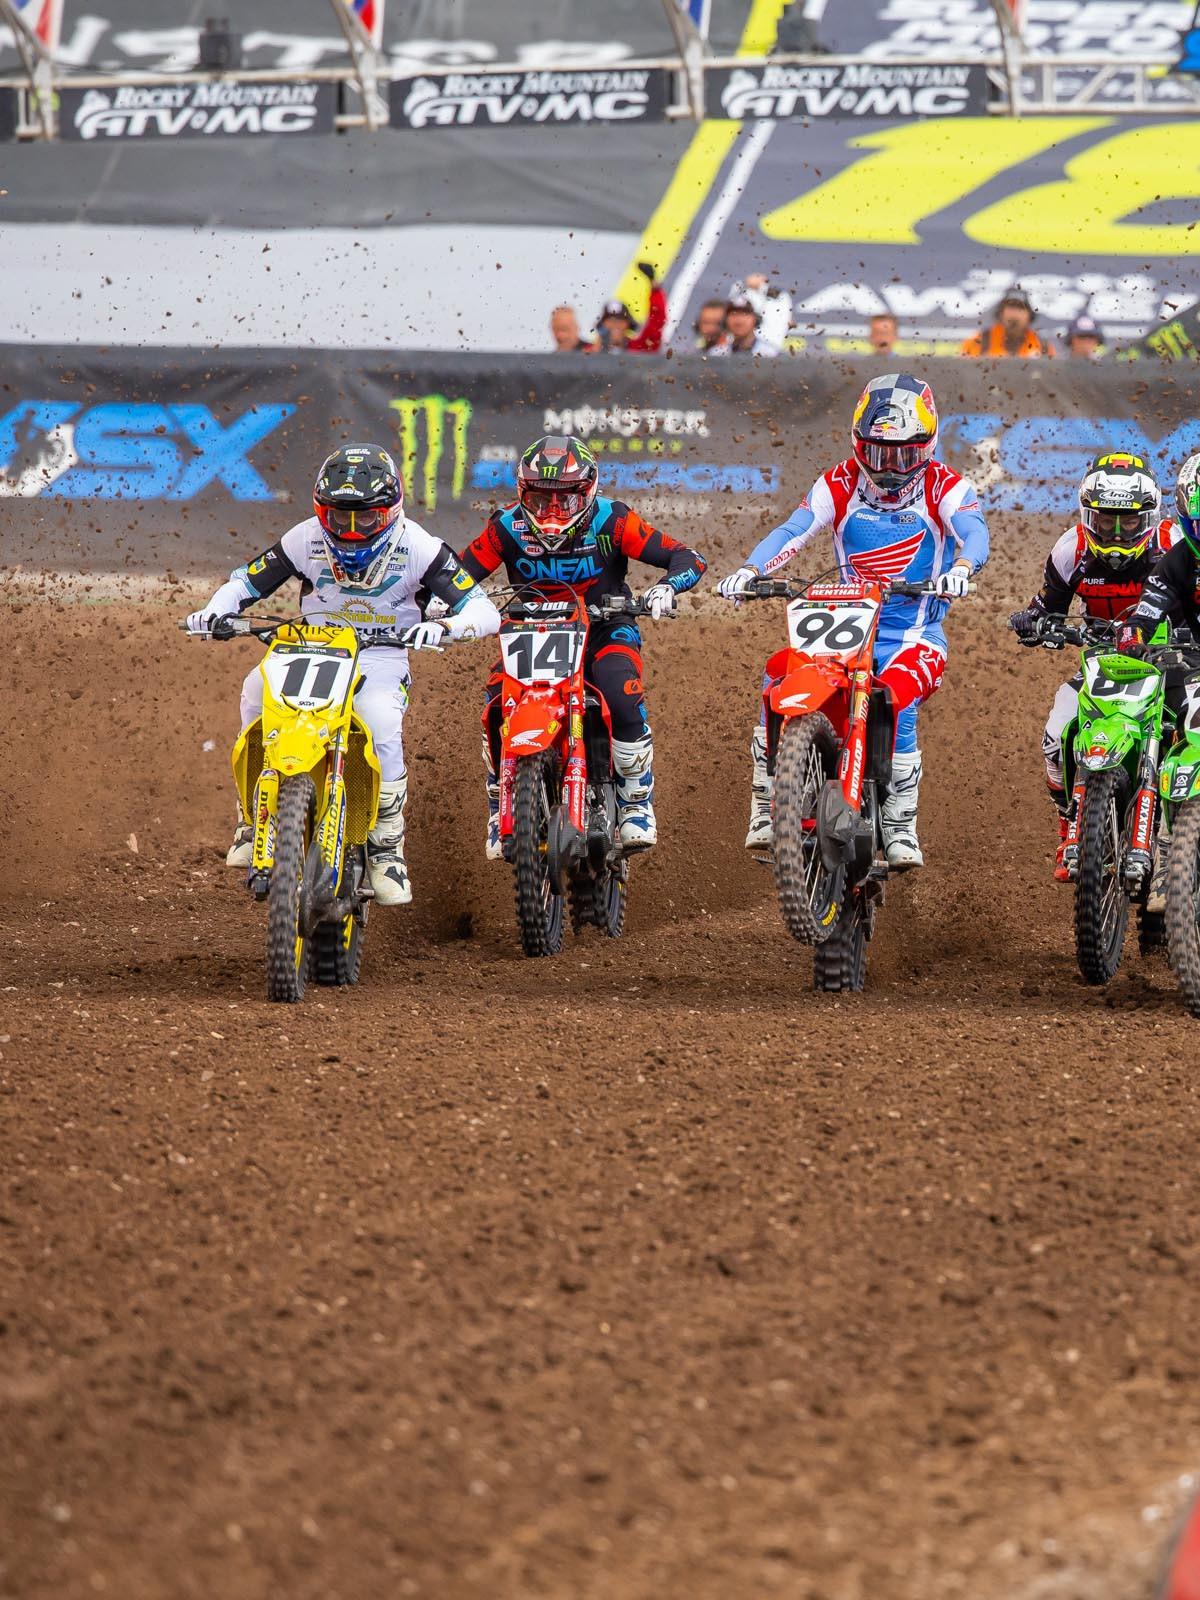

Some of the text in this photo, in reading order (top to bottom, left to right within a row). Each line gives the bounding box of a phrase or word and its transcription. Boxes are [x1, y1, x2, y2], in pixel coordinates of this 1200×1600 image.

[443, 71, 649, 96] ROCKY MOUNTAIN
[760, 65, 971, 89] ROCKY MOUNTAIN
[116, 82, 318, 107] ROCKY MOUNTAIN
[764, 548, 797, 573] HONDA
[1083, 577, 1105, 585] PURE
[796, 612, 864, 650] 96
[508, 633, 572, 680] 14
[282, 658, 341, 699] 11
[850, 738, 864, 801] DUNLOP
[1136, 796, 1150, 844] MAXXIS
